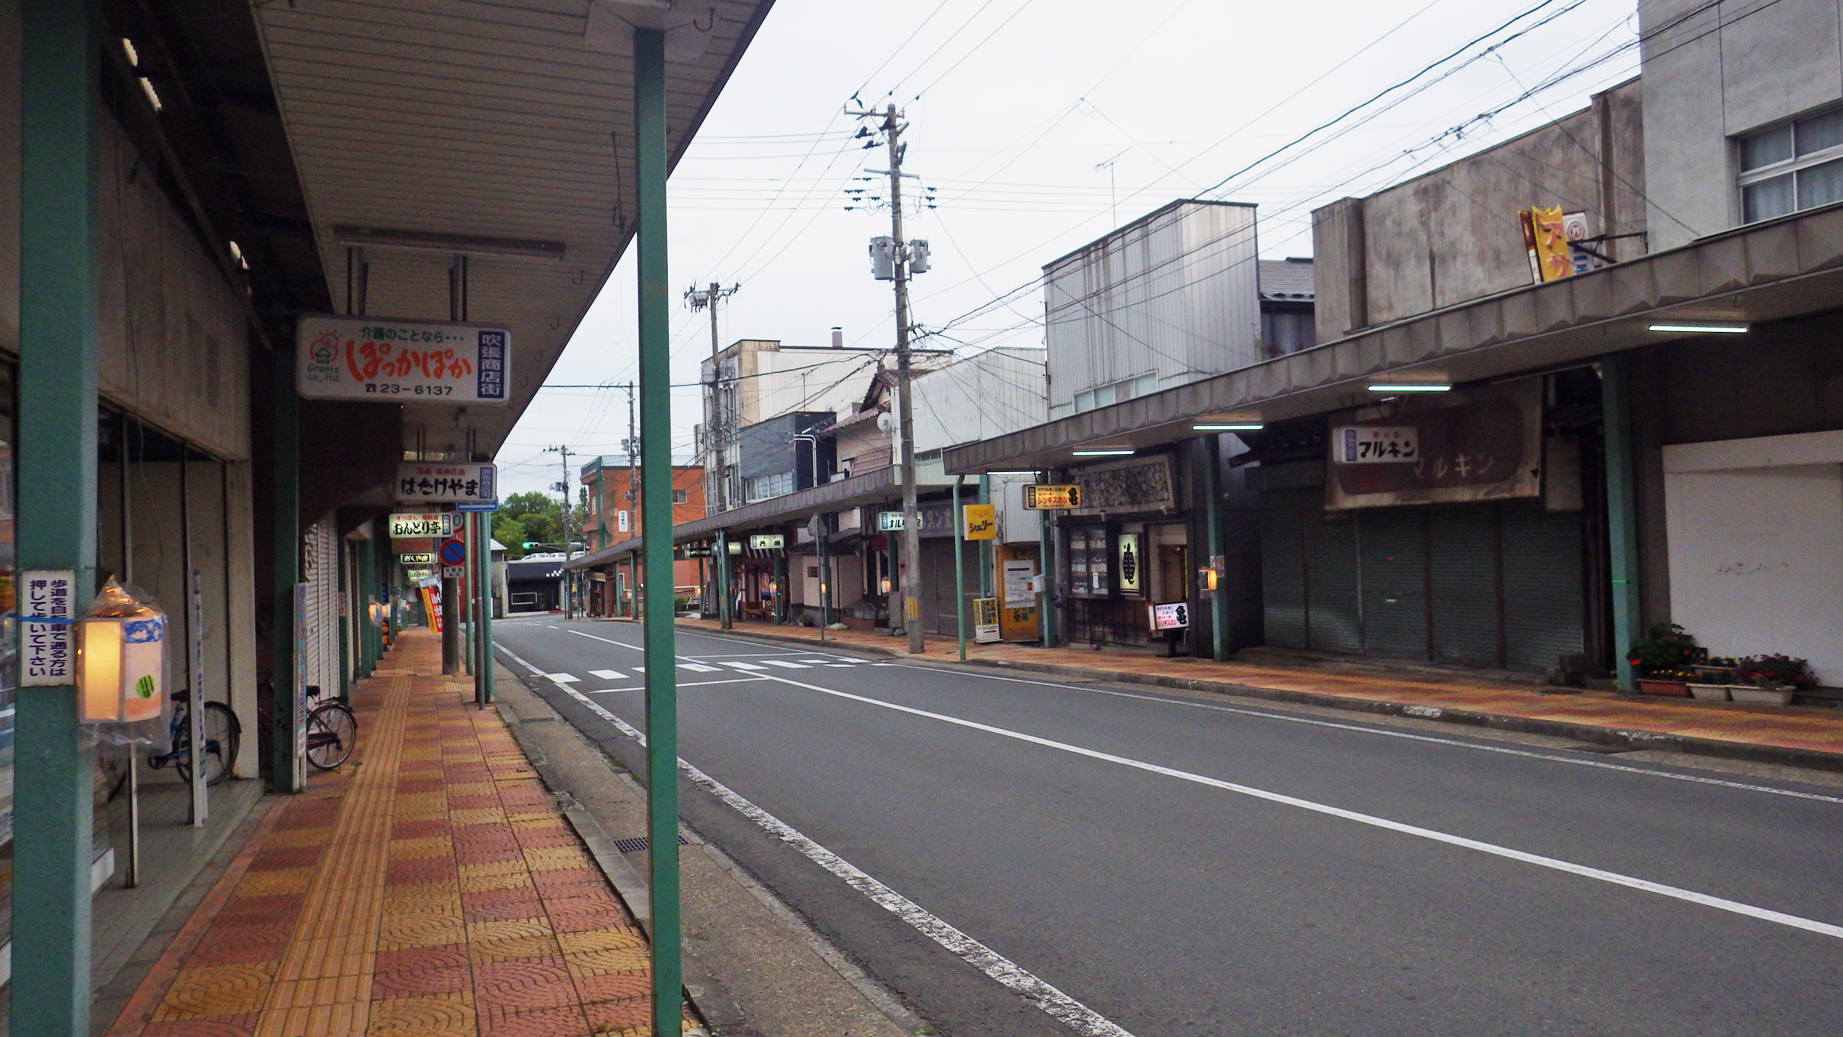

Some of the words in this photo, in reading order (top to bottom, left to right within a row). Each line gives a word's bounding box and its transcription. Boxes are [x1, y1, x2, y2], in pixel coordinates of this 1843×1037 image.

[345, 340, 472, 382] ぽっかぽか
[480, 333, 502, 396] 吹張商店街
[1358, 440, 1416, 458] マルキン
[400, 477, 479, 497] はたけやま
[393, 521, 441, 535] おんどり亭
[969, 520, 993, 533] シェリー
